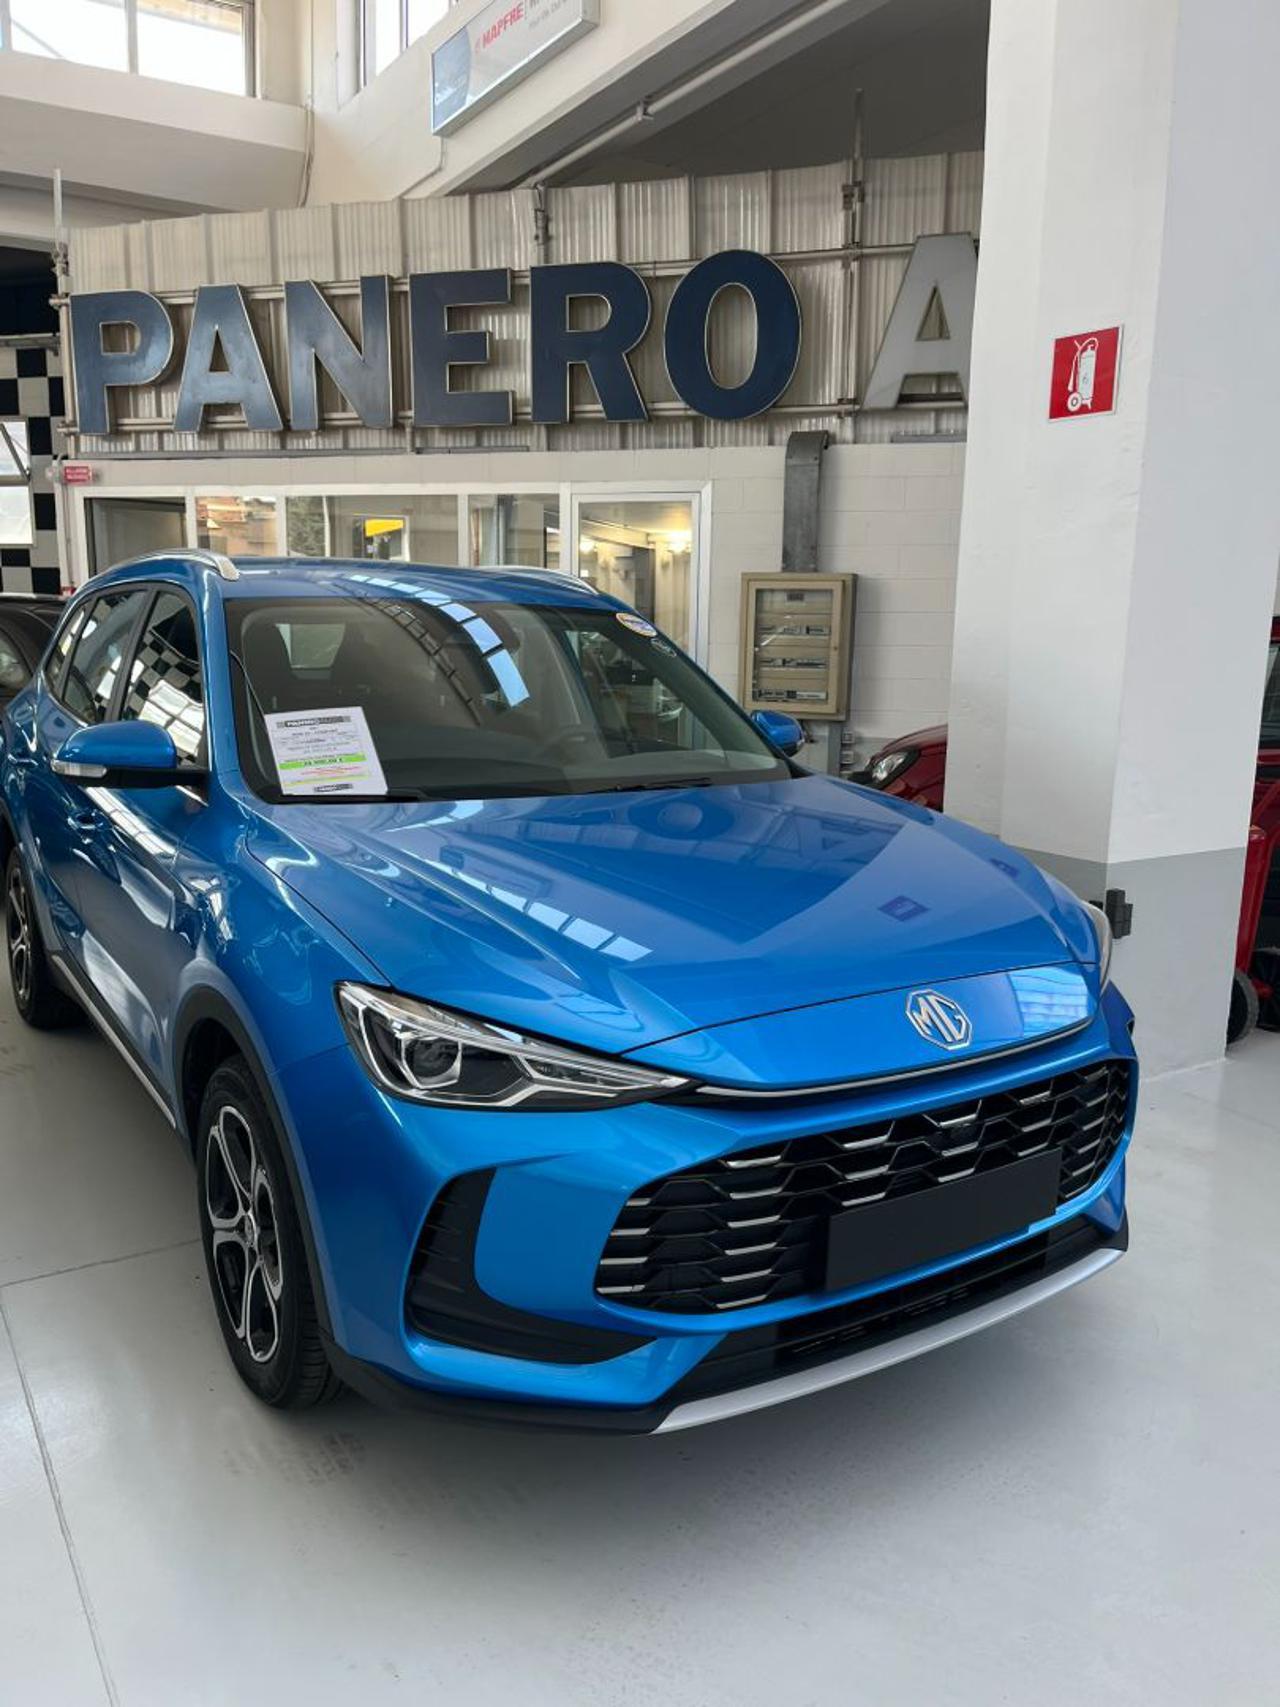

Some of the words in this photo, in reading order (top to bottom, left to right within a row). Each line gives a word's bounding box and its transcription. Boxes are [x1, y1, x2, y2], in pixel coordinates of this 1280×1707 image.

[482, 3, 525, 47] MAPFRE
[70, 249, 802, 436] PANERO
[910, 993, 968, 1044] MG
